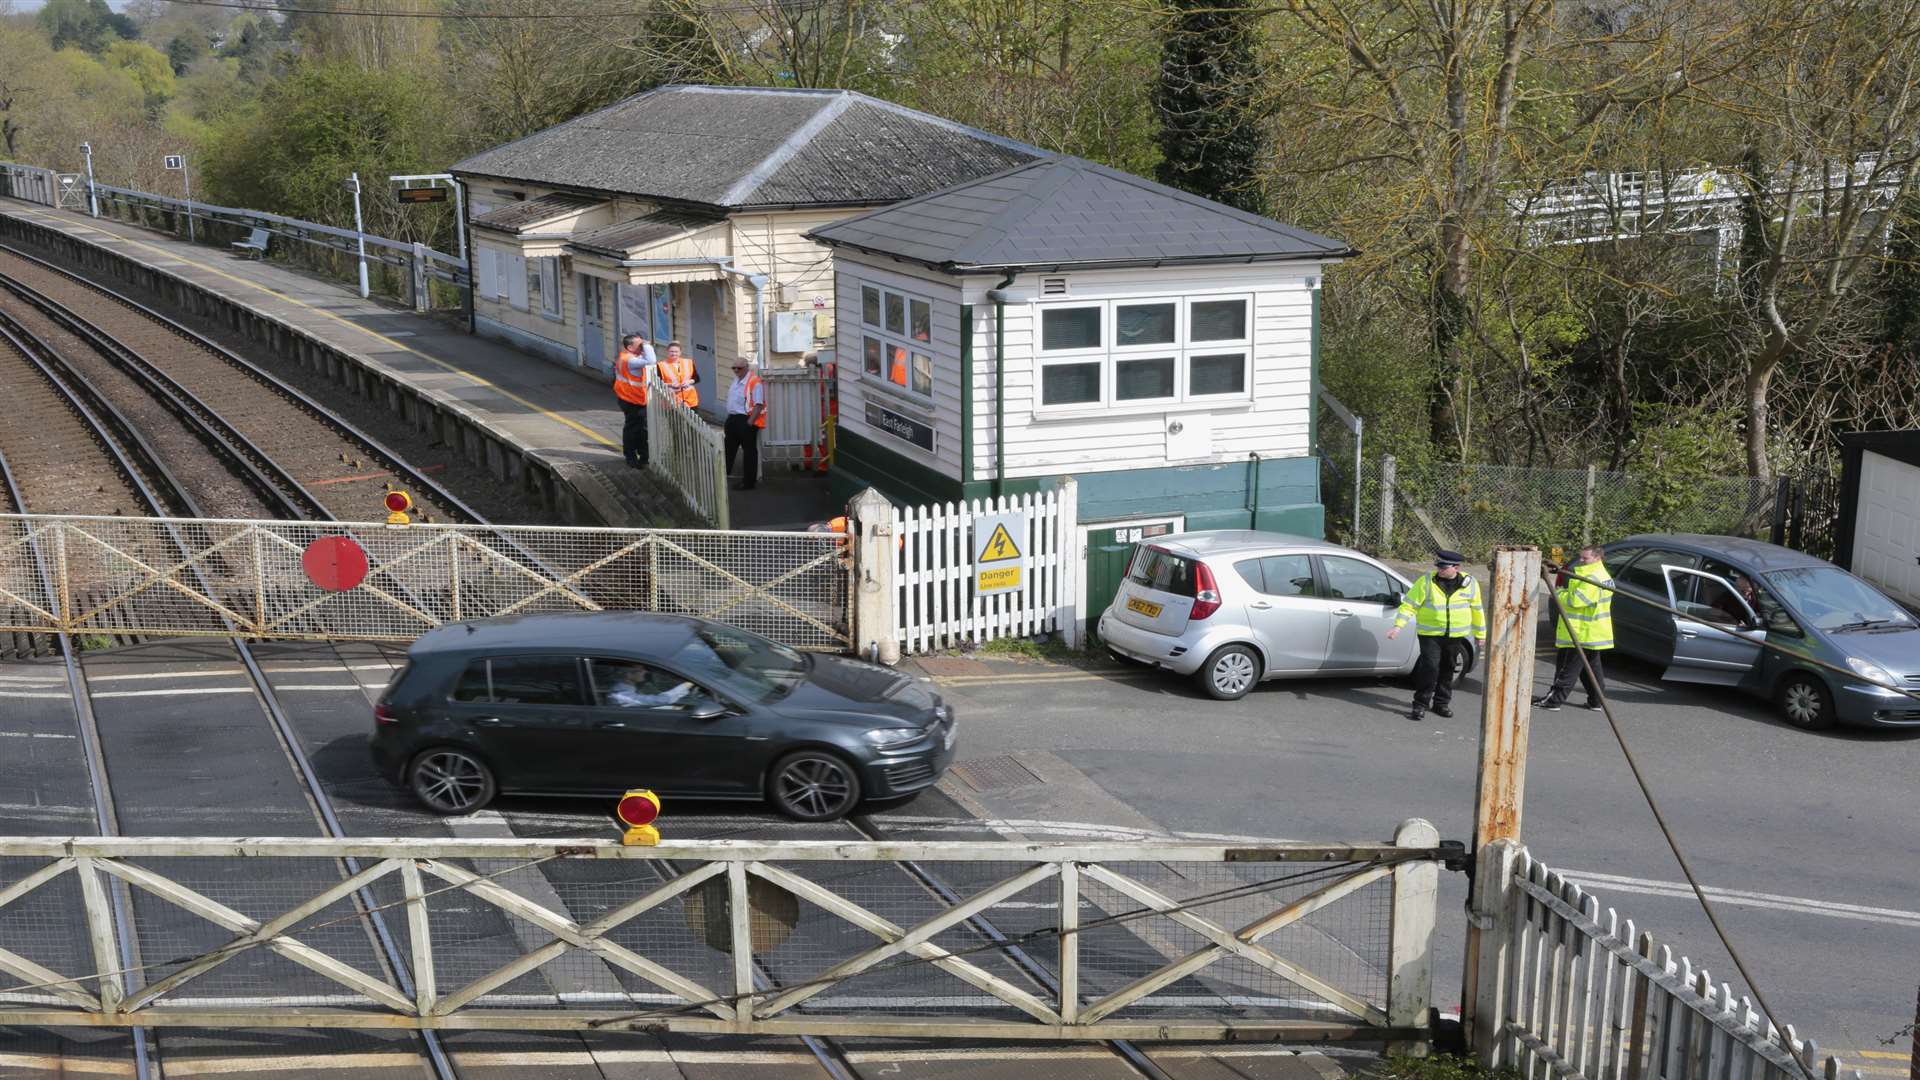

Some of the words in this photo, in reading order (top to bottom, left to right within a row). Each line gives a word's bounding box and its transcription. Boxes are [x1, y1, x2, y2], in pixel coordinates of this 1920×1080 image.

[882, 414, 894, 430] East
[893, 418, 914, 440] Farleigh
[980, 569, 1015, 580] Danger
